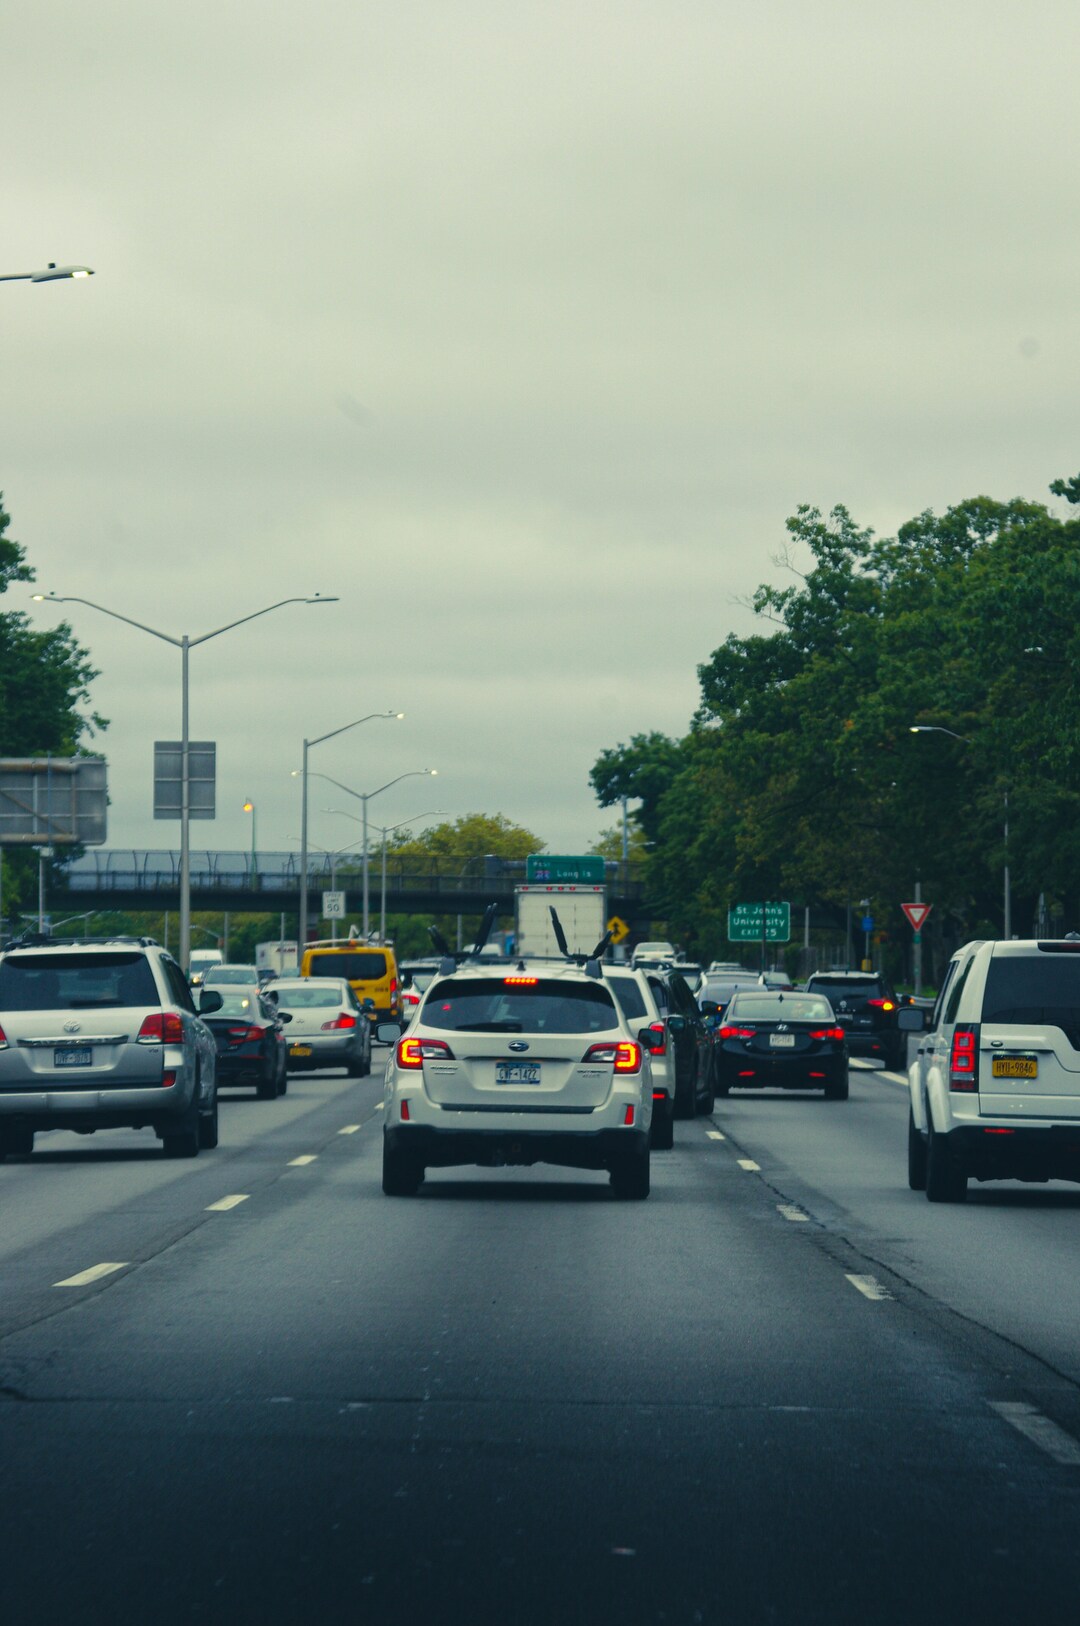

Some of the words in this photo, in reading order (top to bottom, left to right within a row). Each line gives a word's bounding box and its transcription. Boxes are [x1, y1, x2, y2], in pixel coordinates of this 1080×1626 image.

[557, 870, 579, 879] Long
[326, 903, 340, 912] 50
[753, 906, 782, 915] John's
[733, 917, 785, 927] University
[996, 1061, 1033, 1073] HYU-9846
